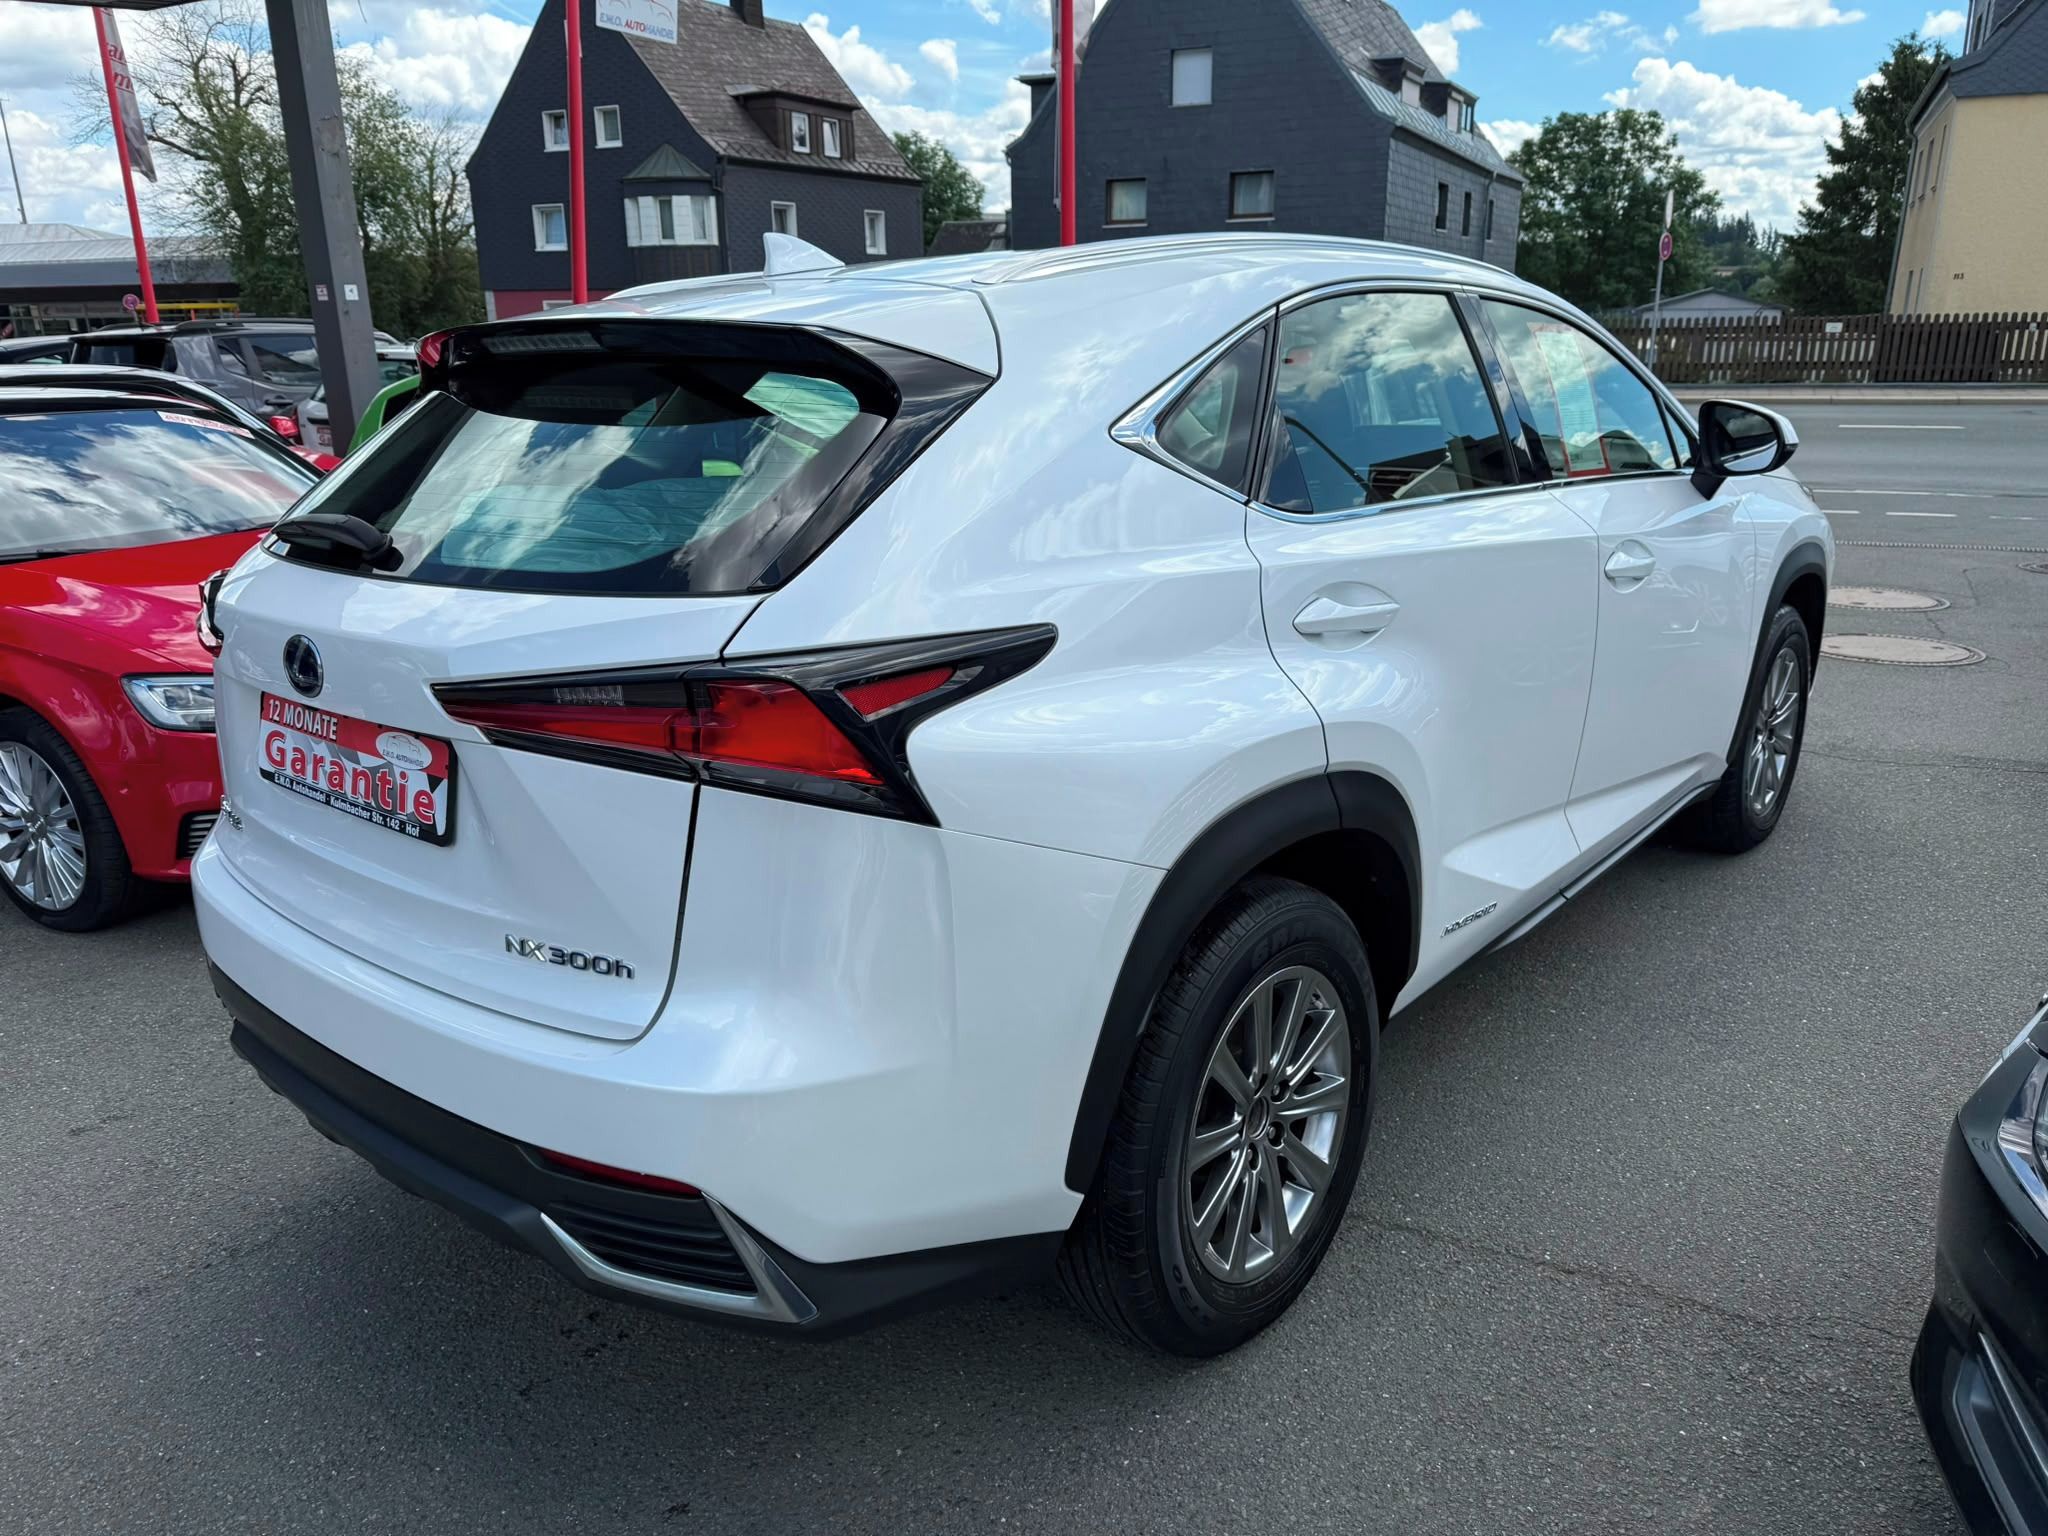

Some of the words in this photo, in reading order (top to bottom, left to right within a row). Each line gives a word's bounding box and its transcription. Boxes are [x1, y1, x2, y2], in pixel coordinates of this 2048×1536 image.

[268, 698, 281, 721] 12
[283, 703, 338, 740] MONATE
[264, 729, 436, 825] Garantie
[292, 780, 326, 803] Autohandel
[330, 795, 371, 819] Kulmbacher
[371, 811, 385, 826] Str.
[386, 817, 400, 830] 142
[405, 825, 420, 838] Hof
